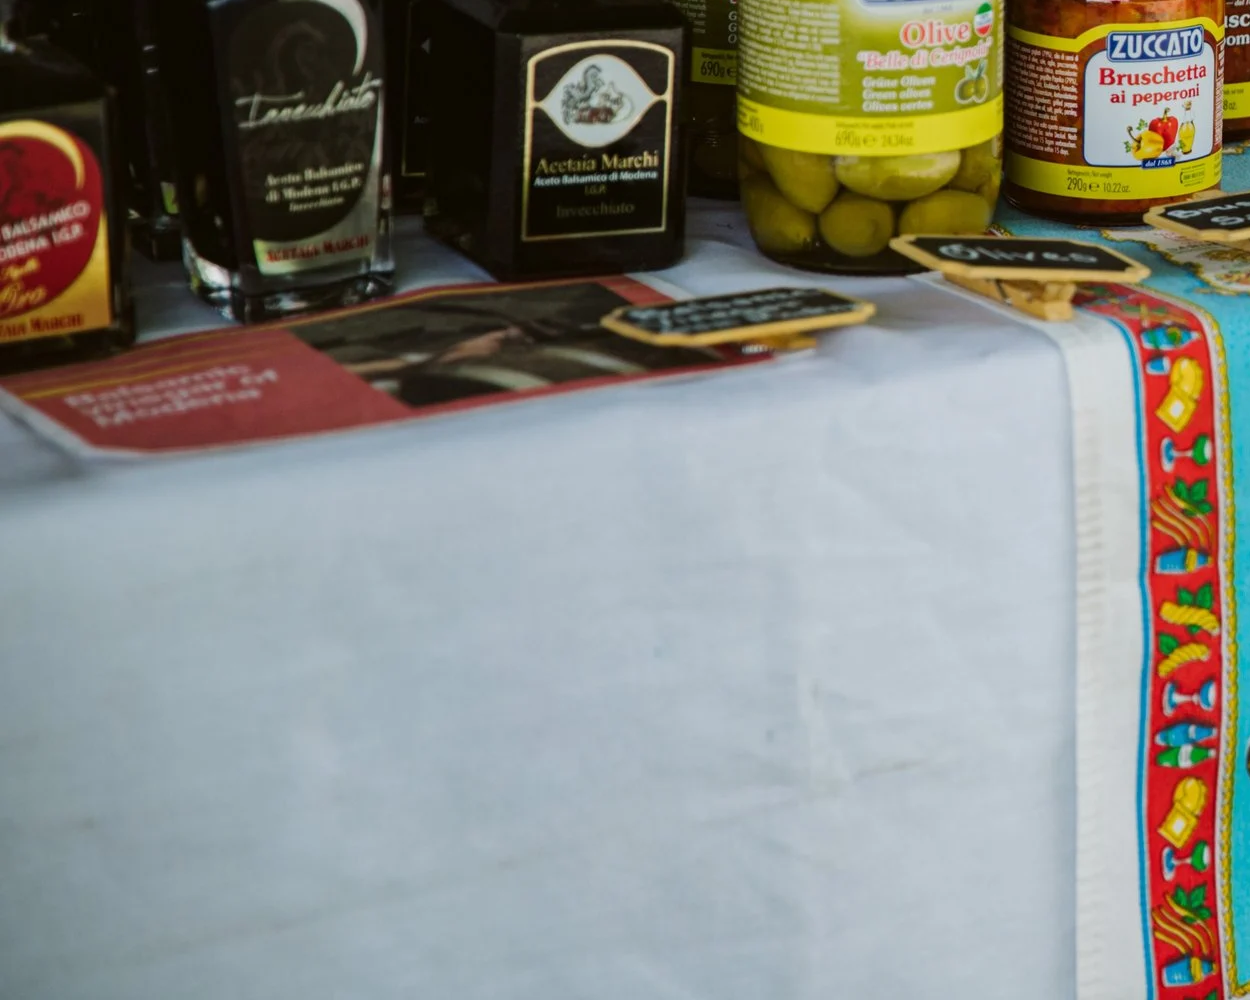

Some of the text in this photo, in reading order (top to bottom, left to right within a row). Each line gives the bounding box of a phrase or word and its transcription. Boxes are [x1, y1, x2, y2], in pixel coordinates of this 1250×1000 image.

[901, 20, 971, 48] Olive
[1111, 29, 1202, 59] ZUCCATO
[1098, 64, 1207, 86] Bruschetta
[1110, 84, 1200, 106] ai peperoni
[535, 150, 660, 175] Acetaia Marchi
[534, 170, 657, 187] Aceto Balsamico di Modena
[1067, 177, 1087, 192] 290g
[1, 200, 91, 239] BALSAMICO
[940, 243, 1099, 264] Olives
